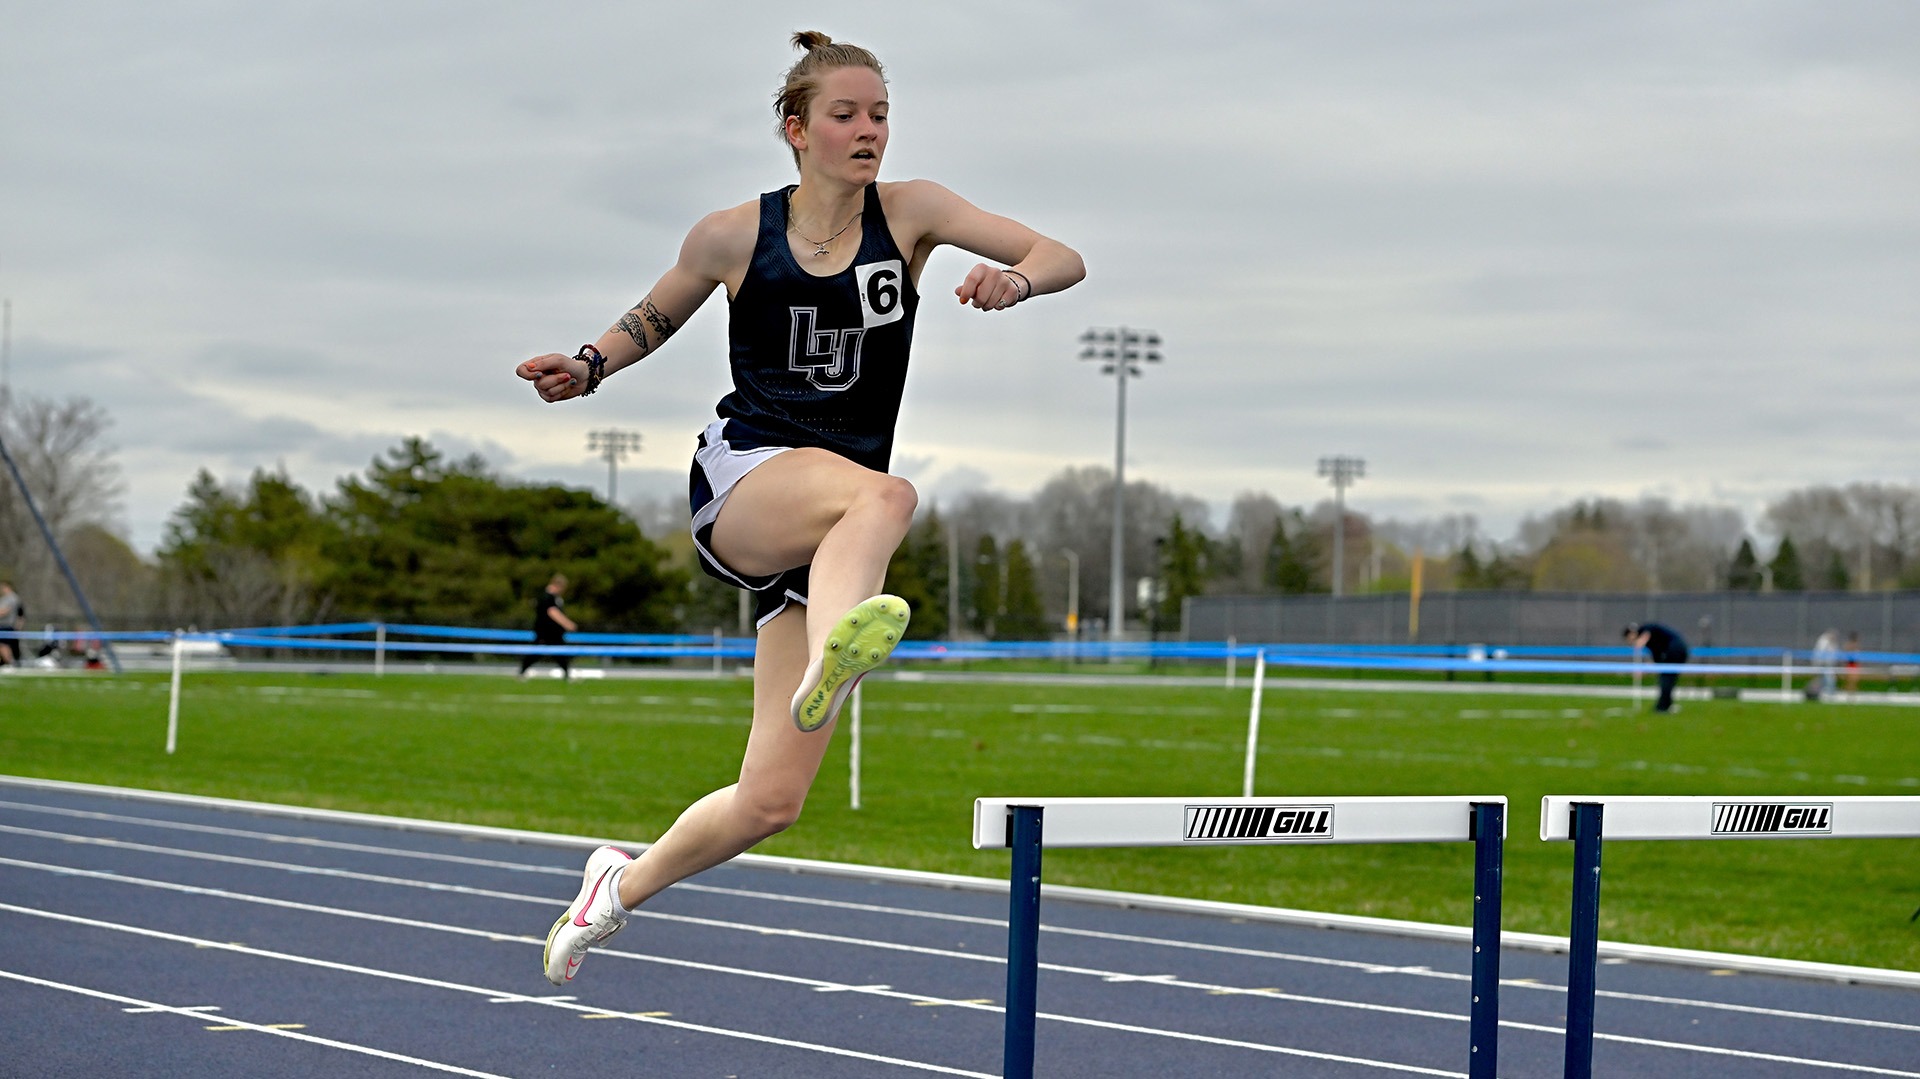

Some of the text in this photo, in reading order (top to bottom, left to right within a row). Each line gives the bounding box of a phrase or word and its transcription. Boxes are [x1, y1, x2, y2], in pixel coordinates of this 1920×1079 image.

[867, 269, 899, 315] 6
[788, 306, 867, 392] LU
[1273, 811, 1329, 834] GILL
[1783, 808, 1829, 829] GILL
